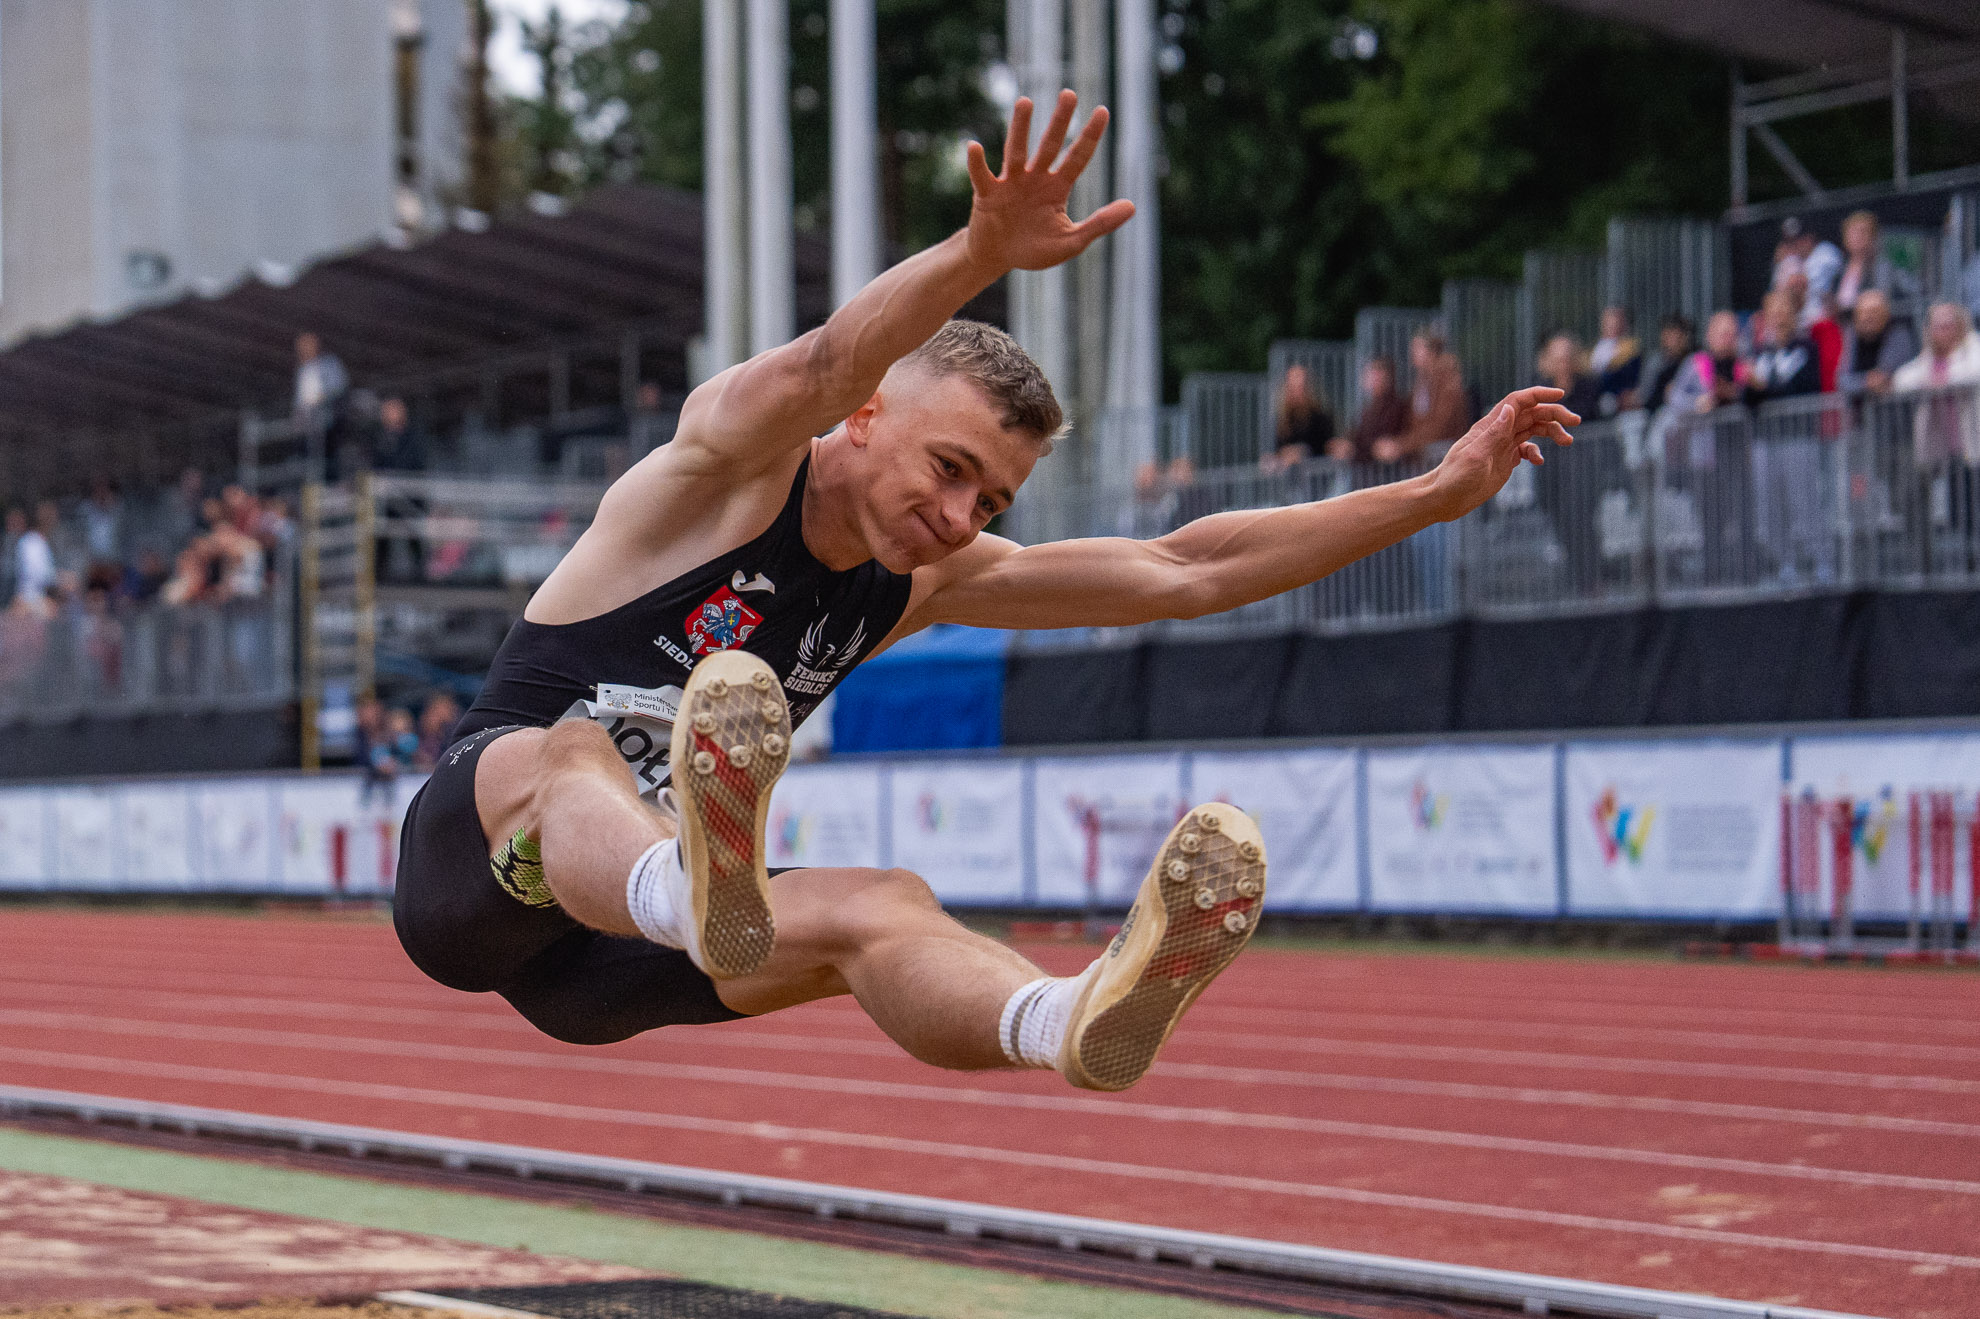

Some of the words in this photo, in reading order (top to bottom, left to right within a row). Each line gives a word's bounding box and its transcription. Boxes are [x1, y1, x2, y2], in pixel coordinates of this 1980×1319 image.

[791, 661, 838, 683] FENIKS
[783, 676, 828, 695] SIEDLCE
[633, 700, 660, 712] Sportu
